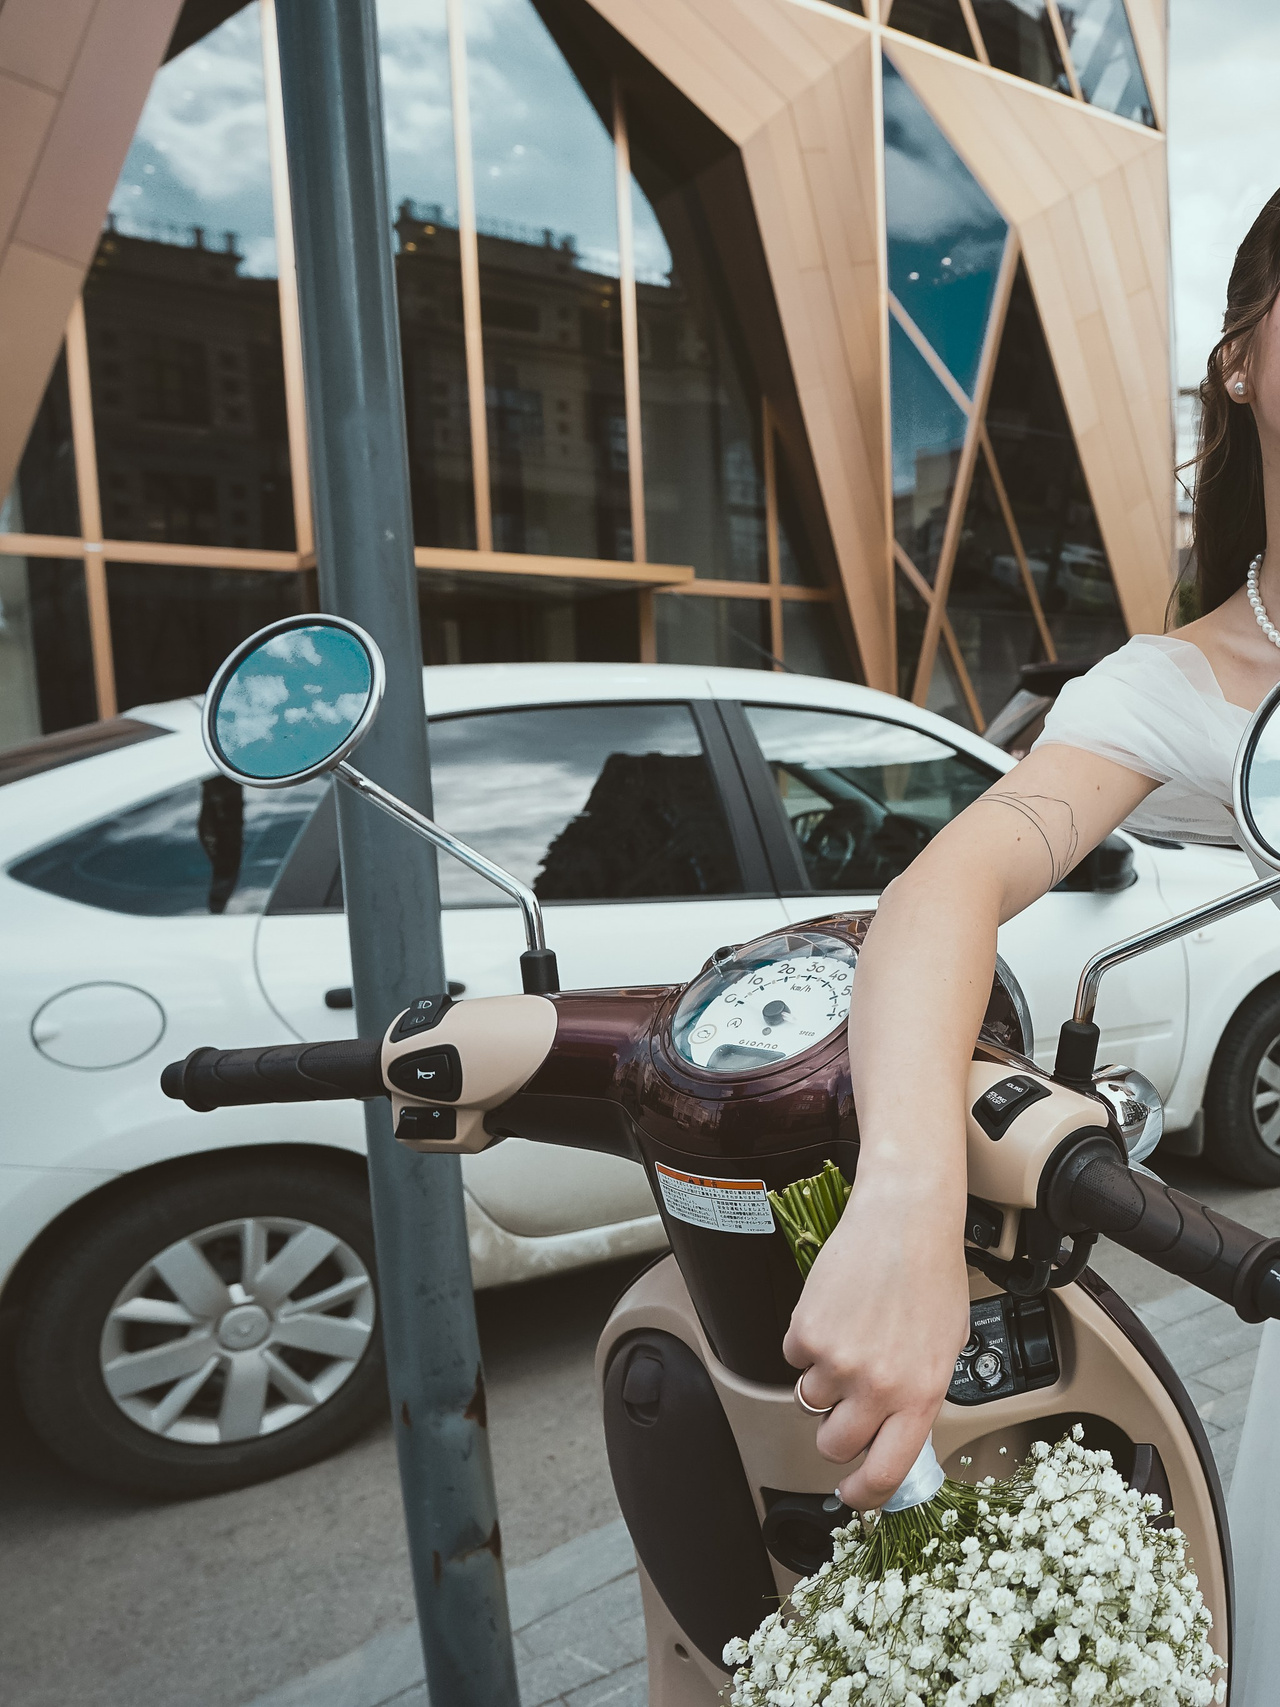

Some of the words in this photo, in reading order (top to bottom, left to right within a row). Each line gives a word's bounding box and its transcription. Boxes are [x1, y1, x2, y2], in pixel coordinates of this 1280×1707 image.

[777, 963, 796, 975] 20
[806, 960, 826, 974] 30
[748, 973, 764, 986] 10
[828, 969, 848, 981] 40
[790, 984, 811, 993] km/h
[841, 985, 852, 997] 5
[724, 993, 736, 1003] 0
[1006, 1083, 1023, 1092] IDLING
[986, 1094, 1002, 1105] STOP
[989, 1091, 1007, 1103] IDLING
[974, 1315, 1001, 1327] IGNITION
[988, 1337, 1004, 1346] SHUT
[954, 1377, 970, 1386] OPEN
